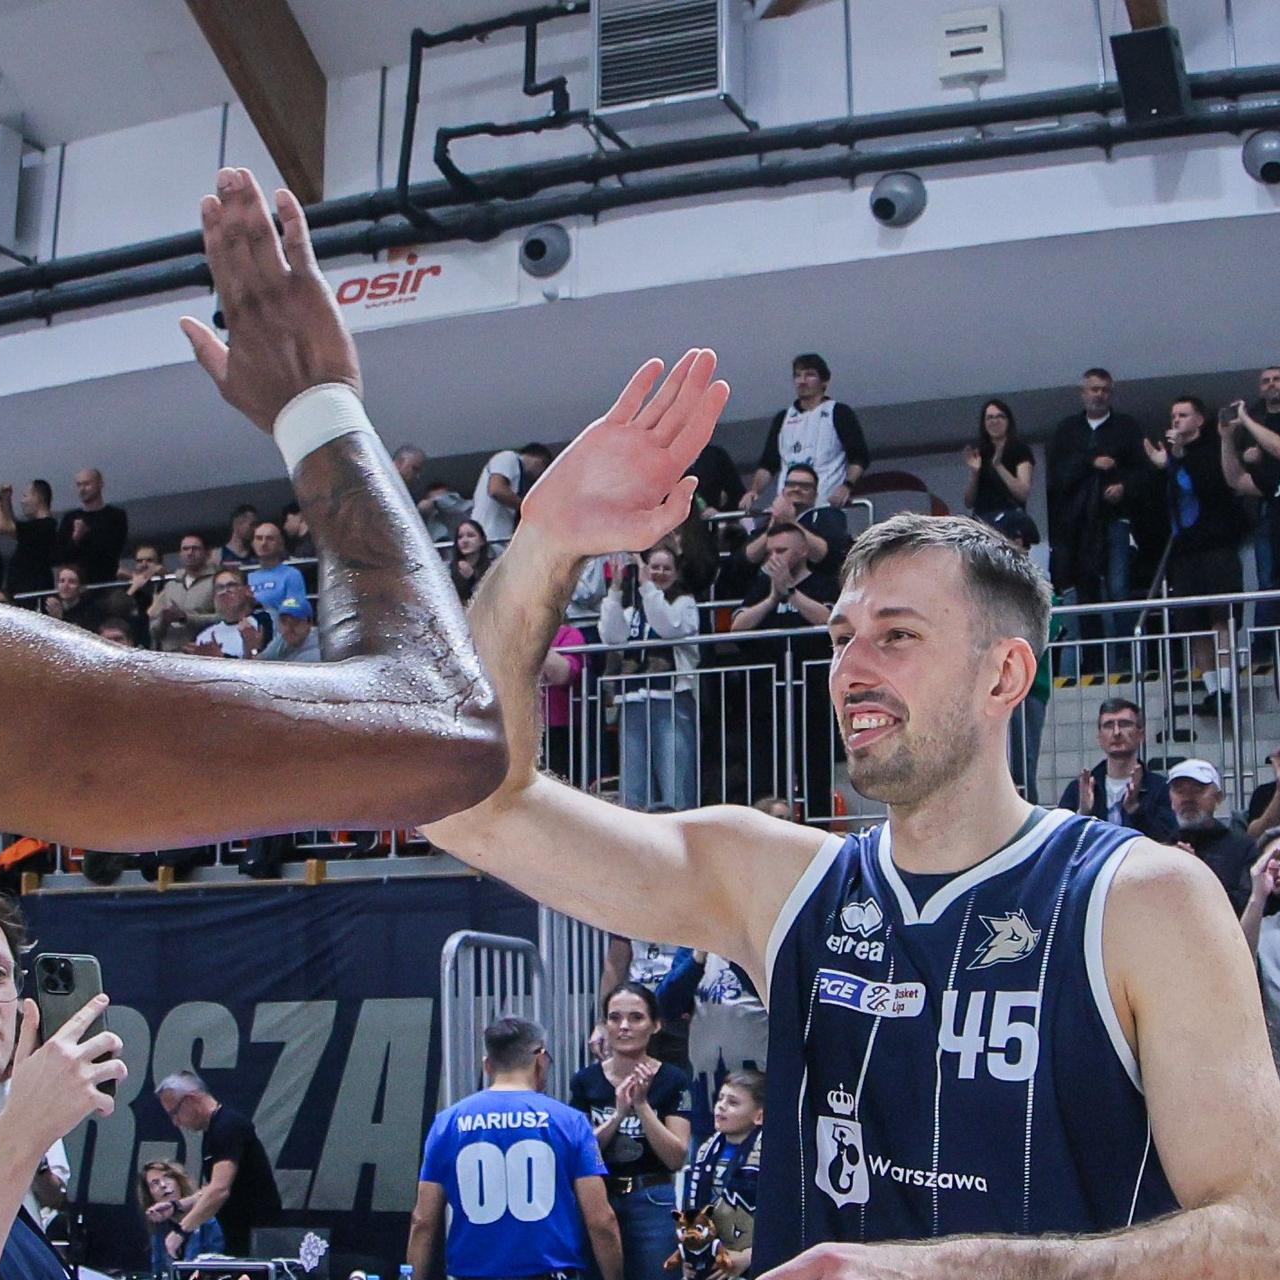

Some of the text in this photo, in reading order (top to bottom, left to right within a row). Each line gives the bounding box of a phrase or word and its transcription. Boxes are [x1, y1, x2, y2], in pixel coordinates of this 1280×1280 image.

[336, 253, 441, 305] osir
[938, 990, 1040, 1082] 45
[458, 1111, 550, 1133] MARIUSZ
[455, 1138, 556, 1225] 00
[869, 1154, 988, 1193] Warszawa
